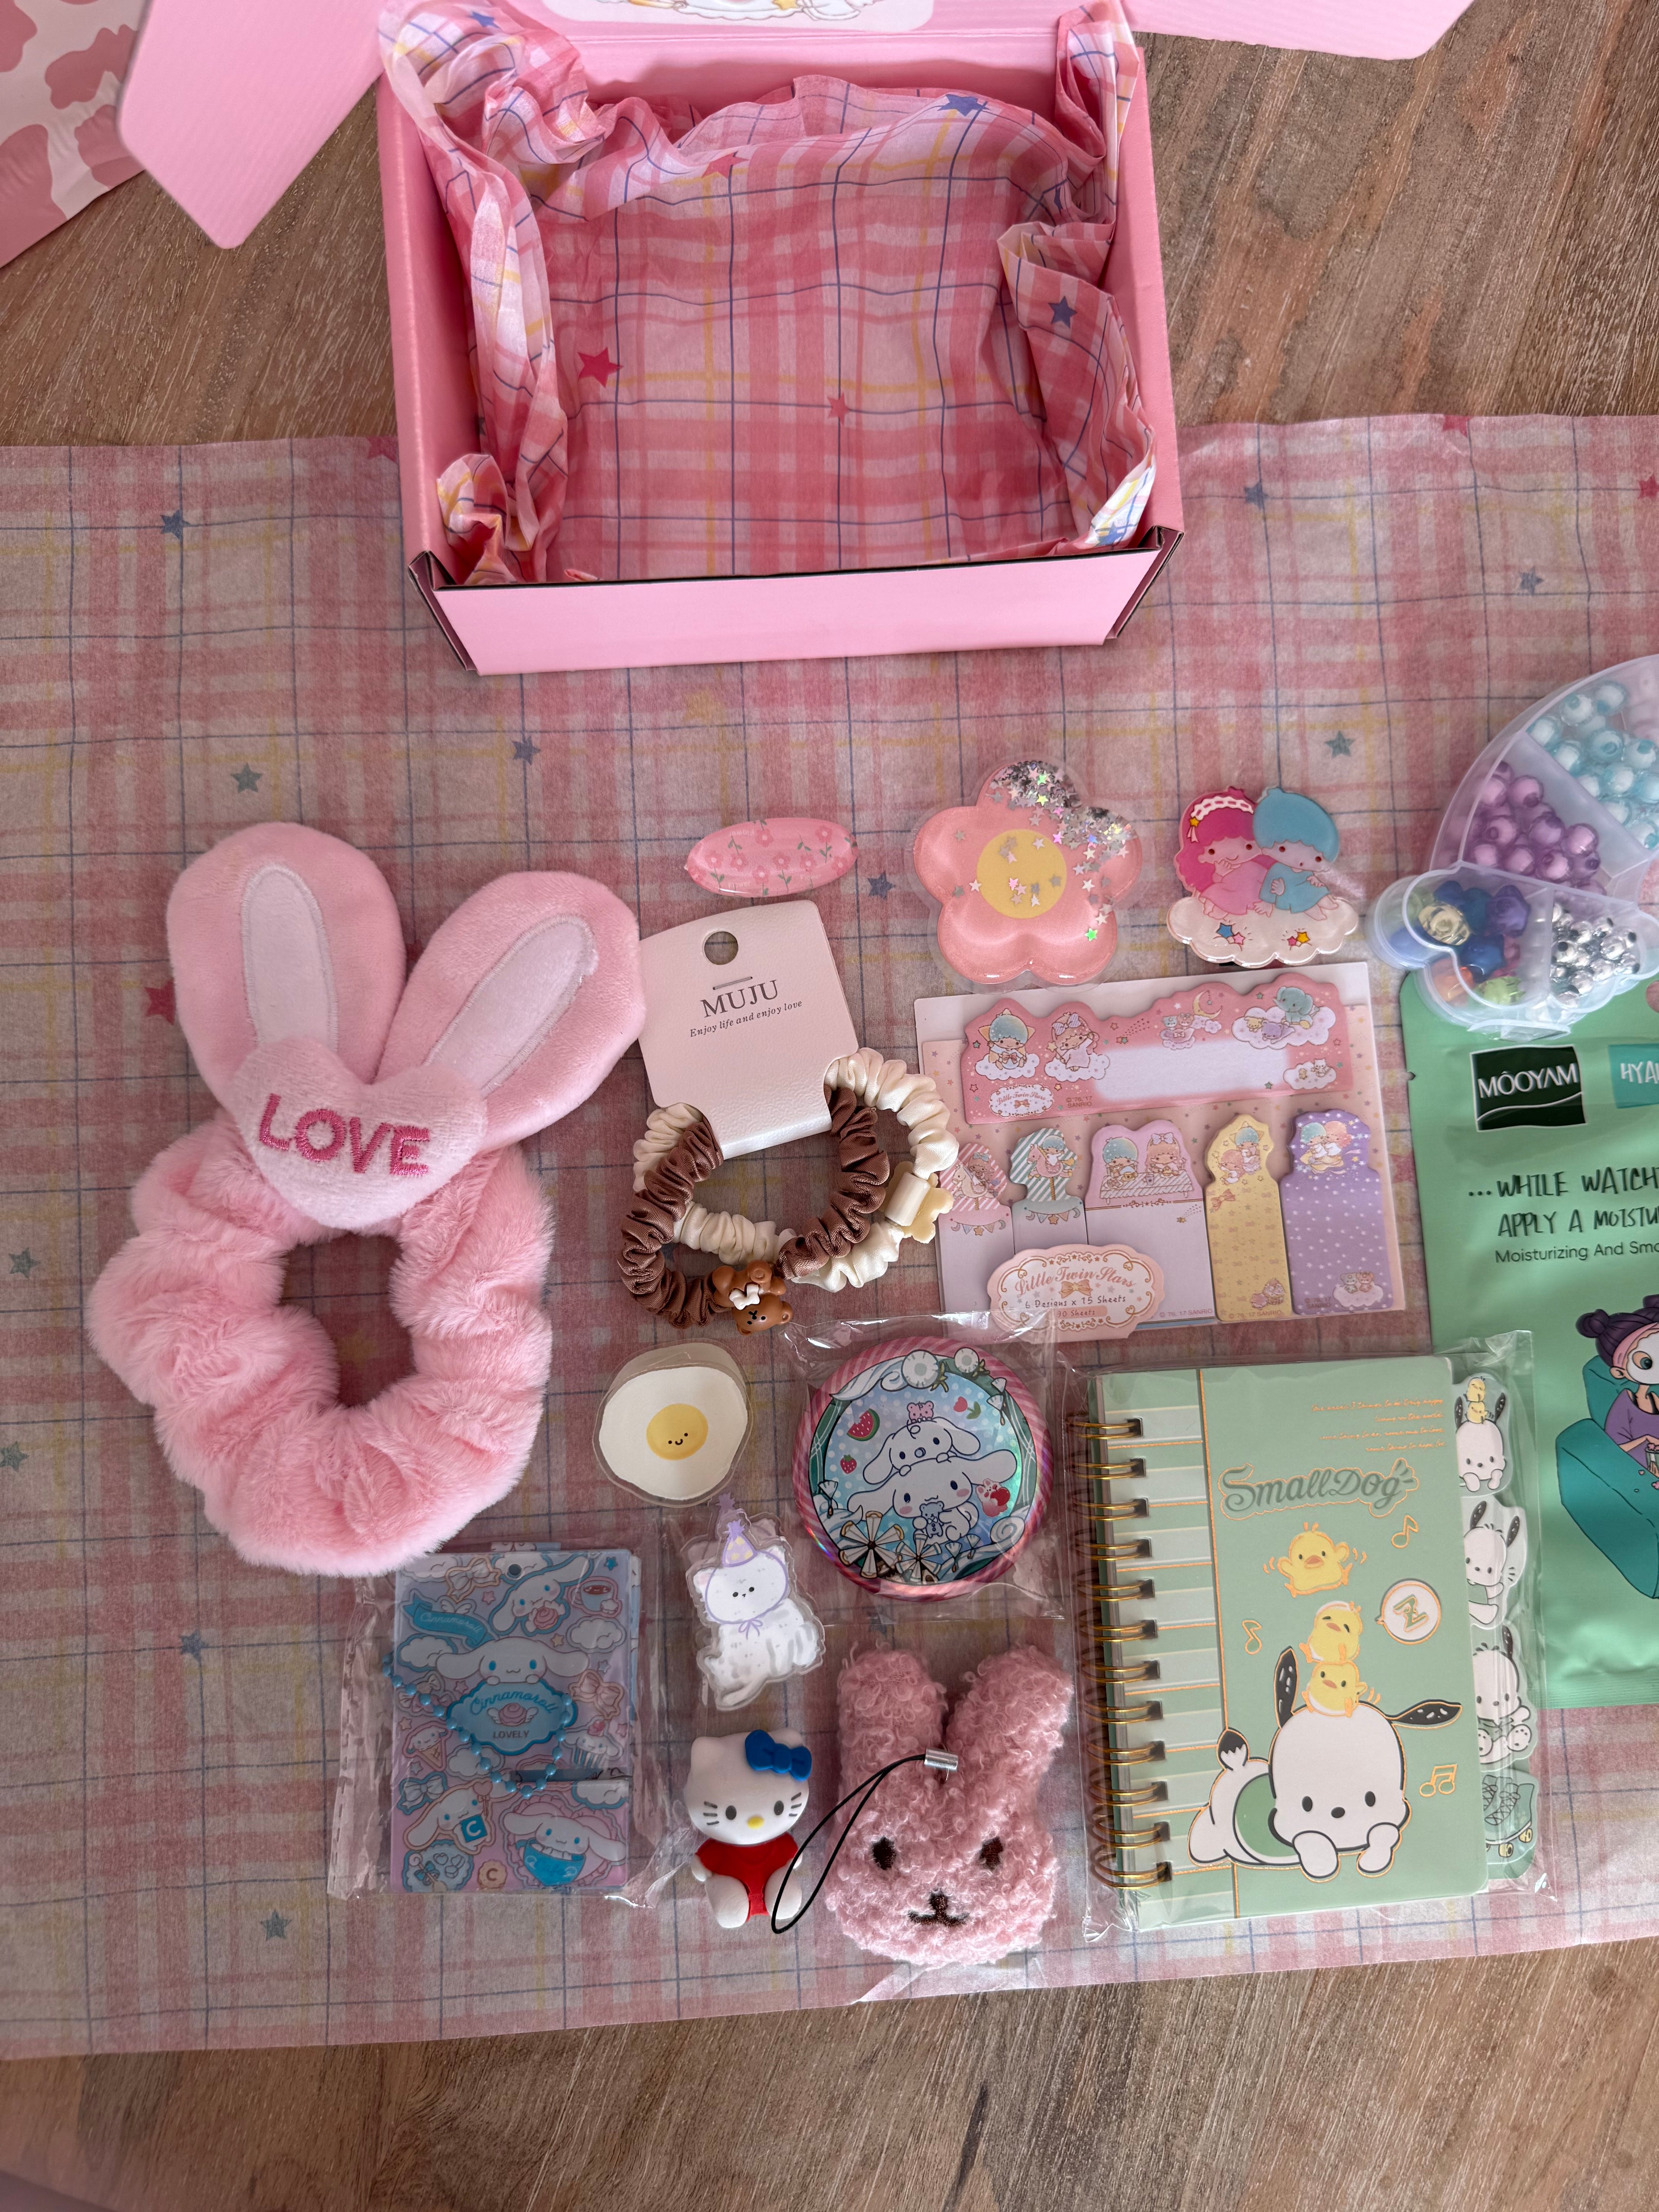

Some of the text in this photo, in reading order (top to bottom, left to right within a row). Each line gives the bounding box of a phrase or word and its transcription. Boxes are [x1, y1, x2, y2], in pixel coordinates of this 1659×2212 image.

[700, 979, 778, 1018] MUJU
[690, 1001, 802, 1037] Enjoy life and enjoy love
[259, 1093, 430, 1176] LOVE
[1581, 1167, 1659, 1194] WATCH
[1498, 1206, 1659, 1237] APPLY A MOISTU
[1495, 1245, 1588, 1263] Moisturizing
[1594, 1242, 1623, 1256] And
[1015, 1266, 1136, 1297] Little Twin Stars
[1035, 1299, 1067, 1308] Designs
[1097, 1295, 1126, 1304] Sheets
[420, 1613, 483, 1633] Cinnamoroll
[470, 1691, 556, 1715] Cinnamoroll
[493, 1730, 530, 1739] LOVELY
[466, 1820, 481, 1837] C
[486, 1868, 498, 1881] C
